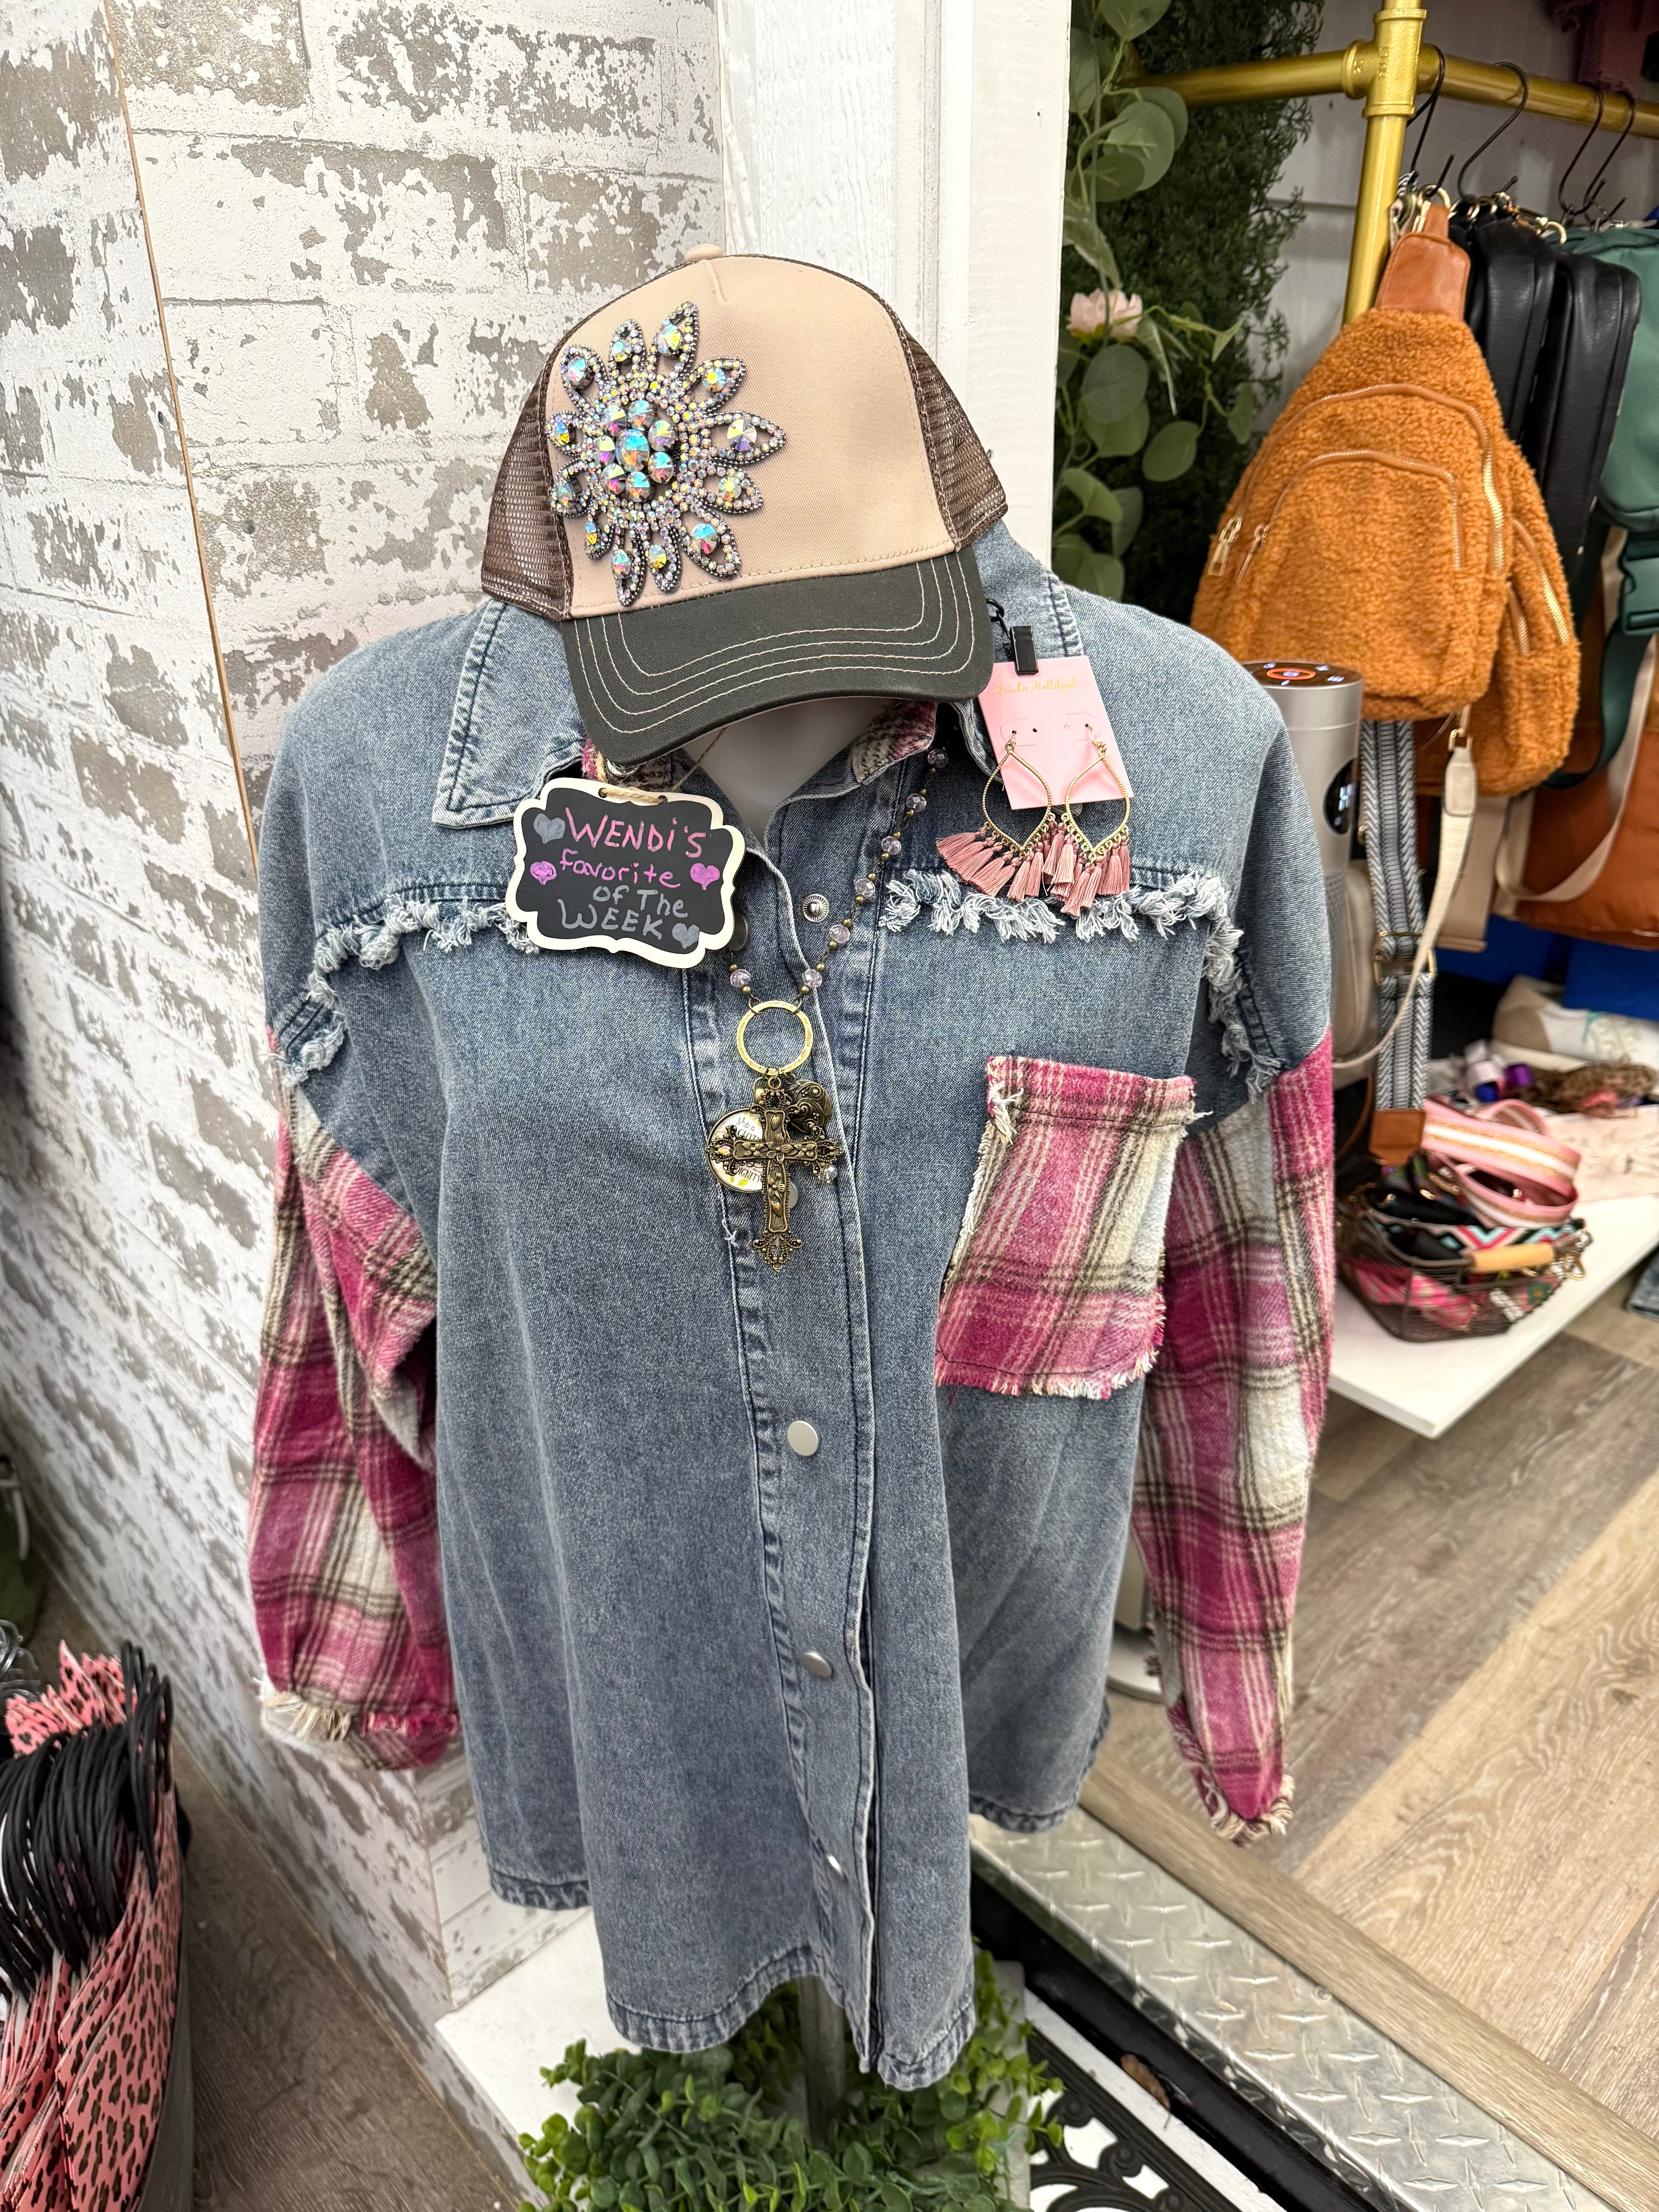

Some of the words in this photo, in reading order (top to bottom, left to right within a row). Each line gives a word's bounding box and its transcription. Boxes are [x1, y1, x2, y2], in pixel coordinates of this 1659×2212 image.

[637, 889, 688, 917] The
[557, 898, 662, 939] WEEK
[737, 1165, 760, 1183] DIGNITY
